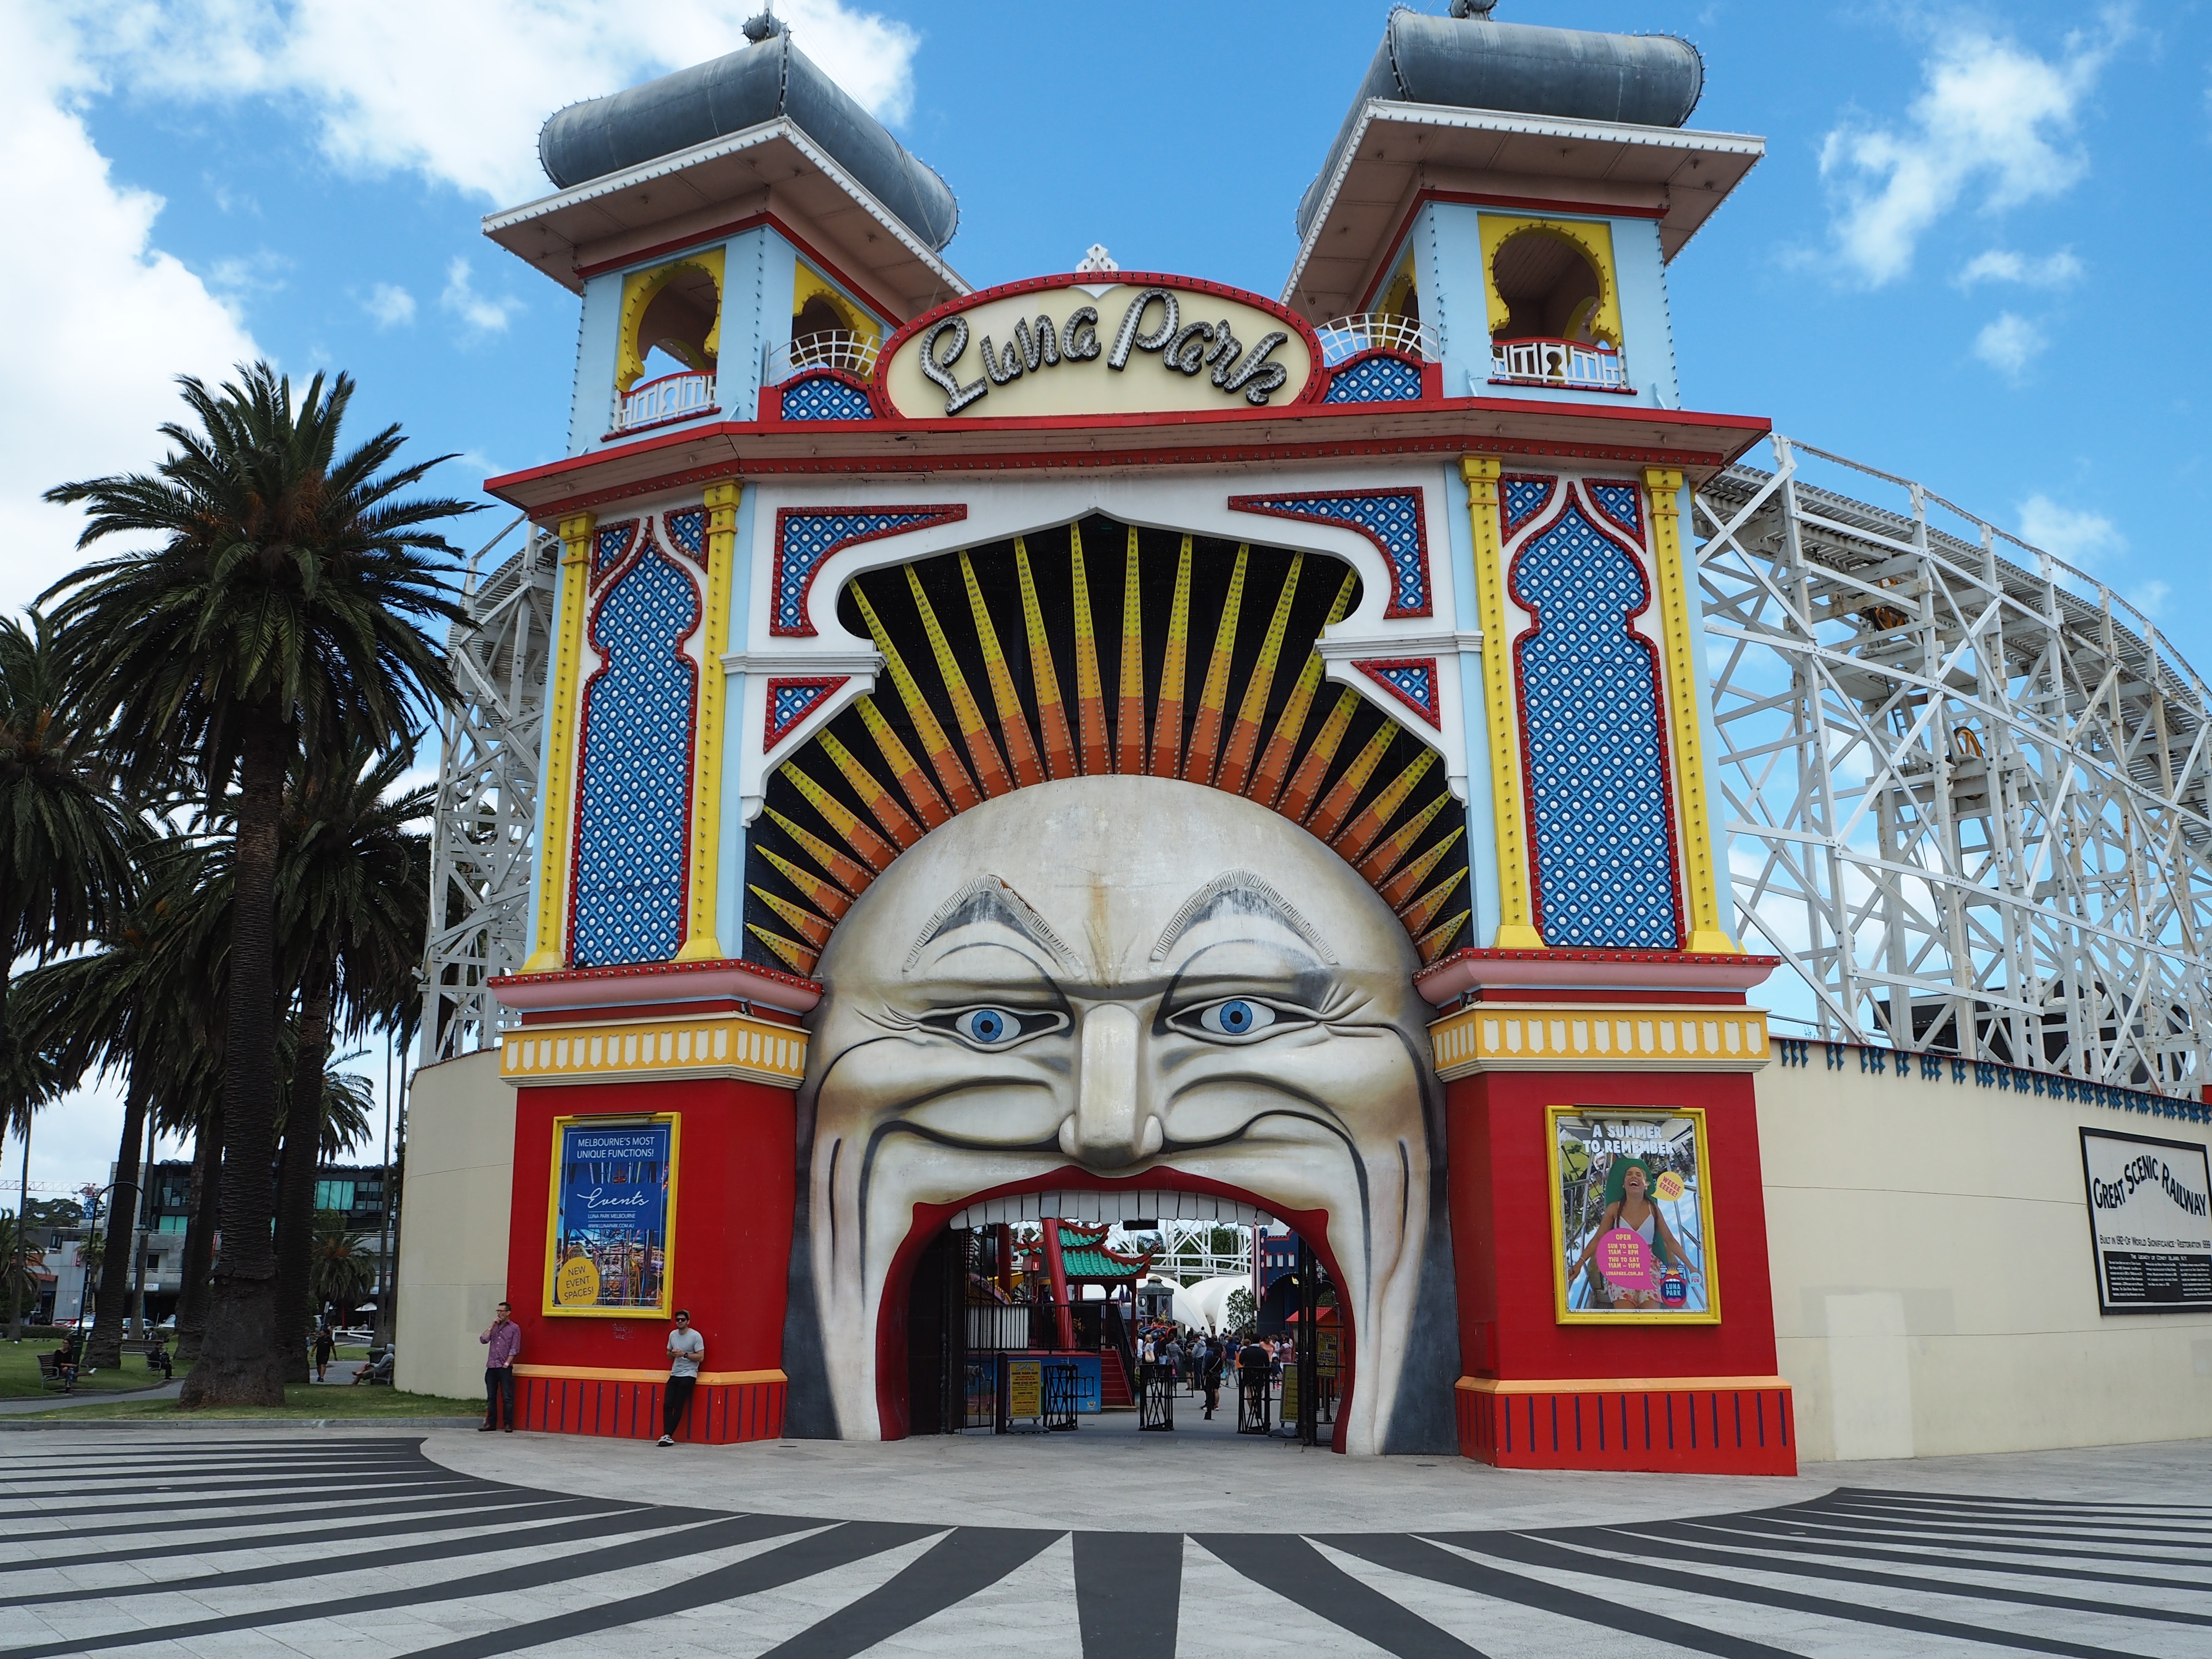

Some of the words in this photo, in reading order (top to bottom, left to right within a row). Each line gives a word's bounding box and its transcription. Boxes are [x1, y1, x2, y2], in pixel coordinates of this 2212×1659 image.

[918, 306, 1102, 417] Luna
[1107, 288, 1288, 406] Park
[1592, 1125, 1603, 1138] A
[1607, 1125, 1663, 1139] SUMMER
[578, 1137, 631, 1147] MELBOURNE'S
[632, 1137, 655, 1145] MOST
[1583, 1140, 1600, 1153] TO
[1604, 1140, 1675, 1154] REMEMBER
[577, 1150, 606, 1158] UNIQUE
[608, 1149, 654, 1157] FUNCTIONS!
[1659, 1182, 1678, 1197] EEEEE!
[1662, 1176, 1681, 1192] WEEEE
[2093, 1178, 2126, 1209] GREAT
[2124, 1155, 2158, 1194] SCENIC
[2162, 1162, 2206, 1216] RAILWAY
[577, 1188, 649, 1208] Events
[568, 1266, 586, 1276] NEW
[566, 1276, 590, 1288] EVENT
[565, 1286, 594, 1300] SPACES!
